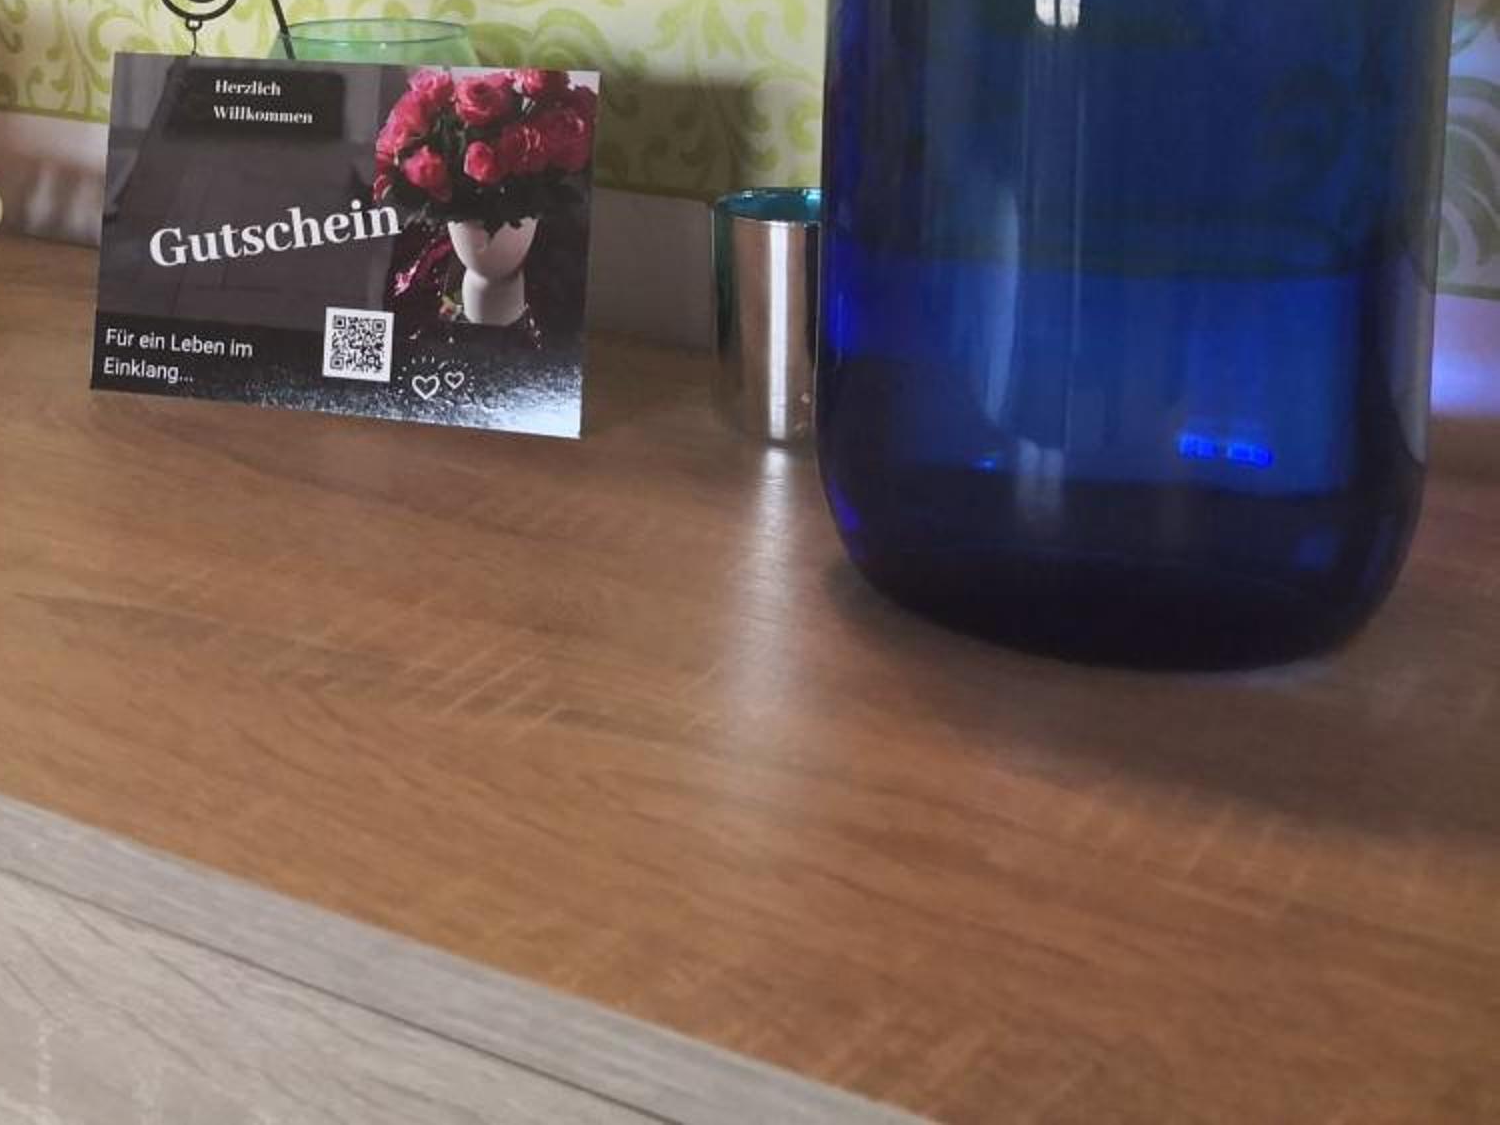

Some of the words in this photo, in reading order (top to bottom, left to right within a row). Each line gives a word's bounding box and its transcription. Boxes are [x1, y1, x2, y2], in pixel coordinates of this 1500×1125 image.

[215, 79, 281, 96] Herzlich
[213, 105, 313, 124] Willkommen
[150, 199, 402, 267] Gutschein
[105, 328, 134, 347] Für
[139, 331, 165, 350] ein
[171, 333, 225, 355] Leben
[230, 338, 253, 358] im
[103, 356, 193, 384] Einklang...
